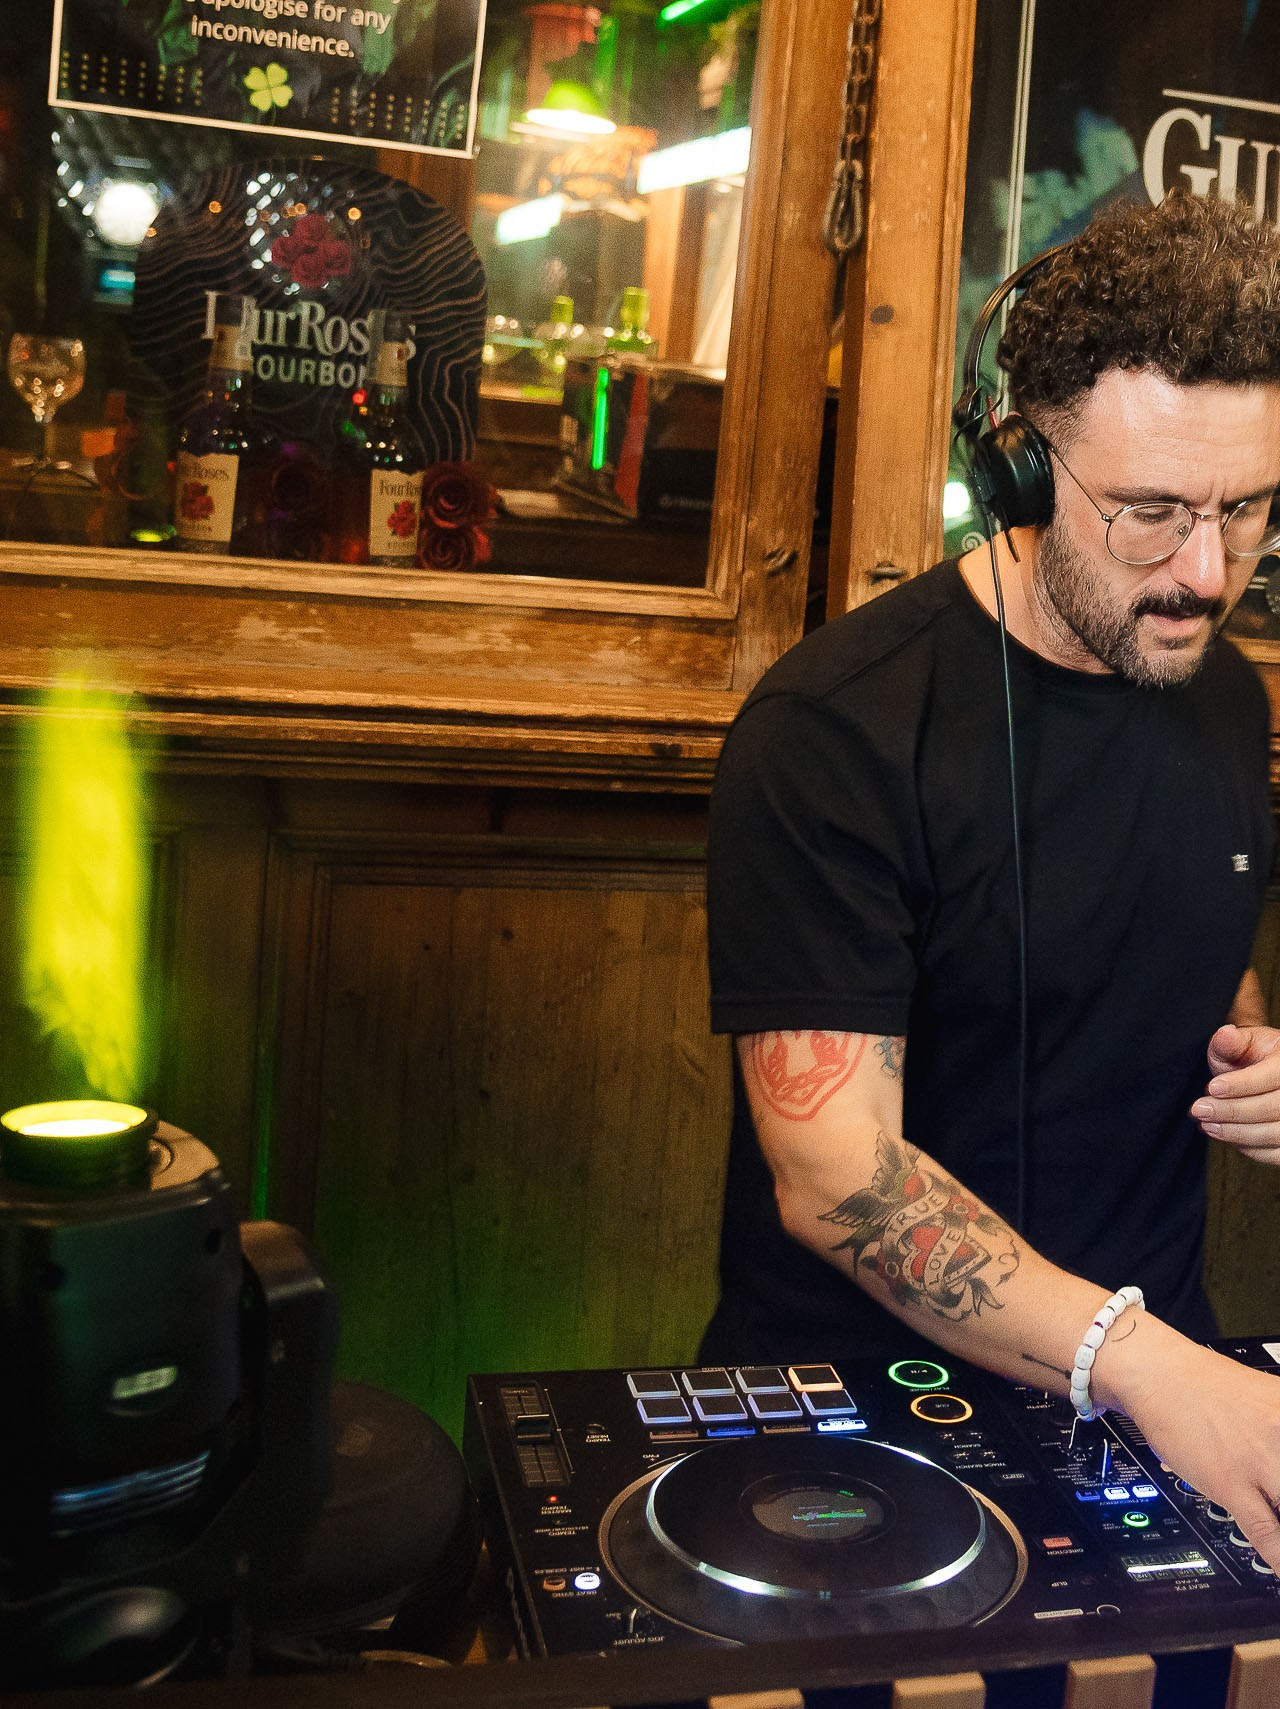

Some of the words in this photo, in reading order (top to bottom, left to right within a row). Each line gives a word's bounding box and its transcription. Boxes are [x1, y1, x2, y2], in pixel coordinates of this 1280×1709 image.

[191, 15, 355, 58] inconvenience.
[314, 1, 347, 23] for
[350, 9, 391, 35] any
[255, 352, 366, 389] OURBO
[886, 1194, 944, 1234] TRUE
[928, 1229, 962, 1286] LOVE
